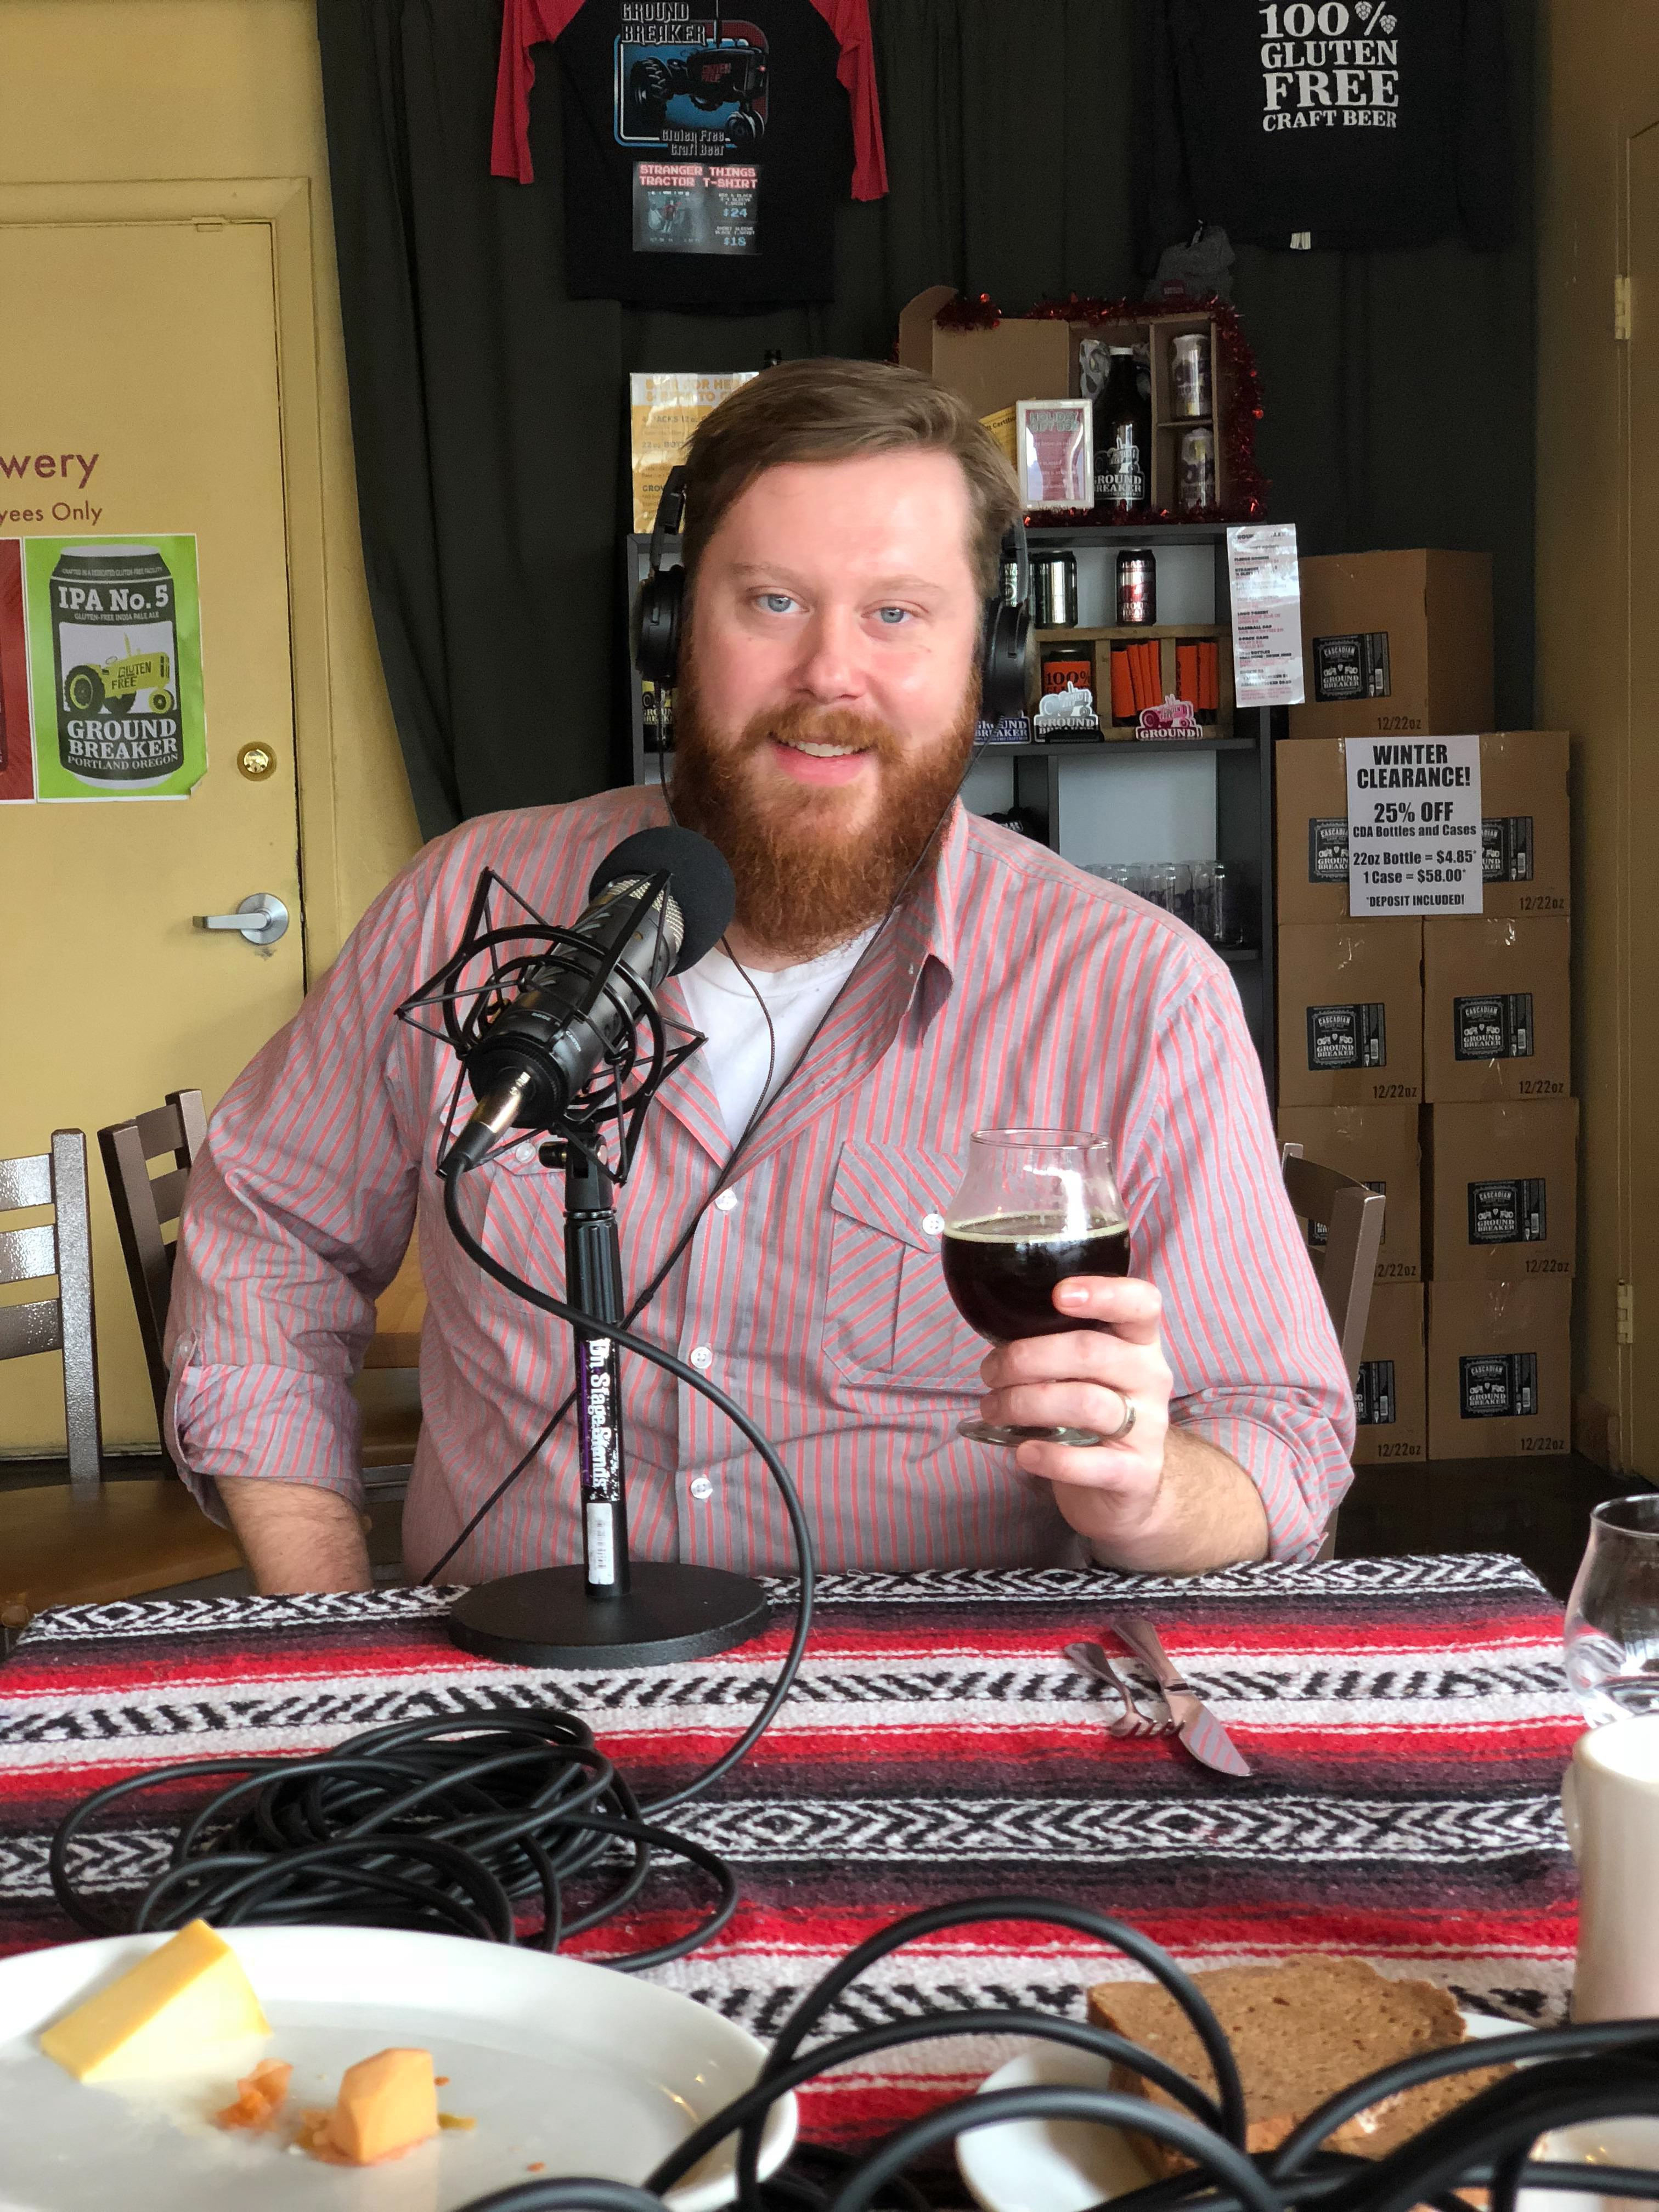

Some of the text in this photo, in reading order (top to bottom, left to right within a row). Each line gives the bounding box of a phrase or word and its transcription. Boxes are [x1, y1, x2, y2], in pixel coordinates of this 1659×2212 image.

[622, 2, 689, 23] GROUND
[622, 24, 707, 46] BREAKER
[1261, 40, 1398, 69] GLUTEN
[1263, 70, 1398, 111] FREE
[1262, 110, 1397, 132] CRAFT BEER
[639, 165, 756, 177] STRANGER THINGS
[639, 176, 758, 189] TRACTOR T-SHIRT
[0, 454, 99, 489] wery
[52, 500, 102, 526] Only
[58, 584, 168, 611] IPA No. 5
[74, 613, 114, 621] GLUTEN-FREE
[1323, 646, 1355, 657] CASCADIAN
[118, 661, 151, 678] GLUTEN
[111, 676, 137, 690] FREE
[1323, 675, 1359, 684] GROUND
[67, 719, 177, 740] GROUND
[1039, 718, 1095, 727] GROUND
[1378, 716, 1421, 730] 12/22oz
[1140, 729, 1196, 738] GROUND
[67, 738, 178, 759] BREAKER
[1373, 744, 1448, 765] WINTER
[67, 754, 178, 770] PORTLAND OREGON
[1357, 767, 1471, 789] CLEARANCE!
[1374, 802, 1453, 823] 25% OFF
[1353, 825, 1476, 838] CDA Bottles and Cases
[1353, 853, 1380, 865] 22oz
[1383, 851, 1421, 865] Bottle
[1364, 872, 1369, 884] 1
[1372, 871, 1402, 883] Case
[1413, 894, 1464, 906] INCLUDED!
[1520, 896, 1565, 910] 12/22oz
[1465, 1007, 1498, 1016] CASCADIAN
[1318, 1016, 1350, 1025] CASCADIAN
[1372, 1085, 1417, 1099] 12/22oz
[1519, 1081, 1563, 1094] 12/22oz
[1479, 1191, 1511, 1200] CASCADIAN
[1525, 1260, 1569, 1273] 12/22oz
[1471, 1365, 1503, 1375] CASCADIAN
[1378, 1443, 1421, 1457] 12/22oz
[1521, 1437, 1564, 1451] 12/22oz
